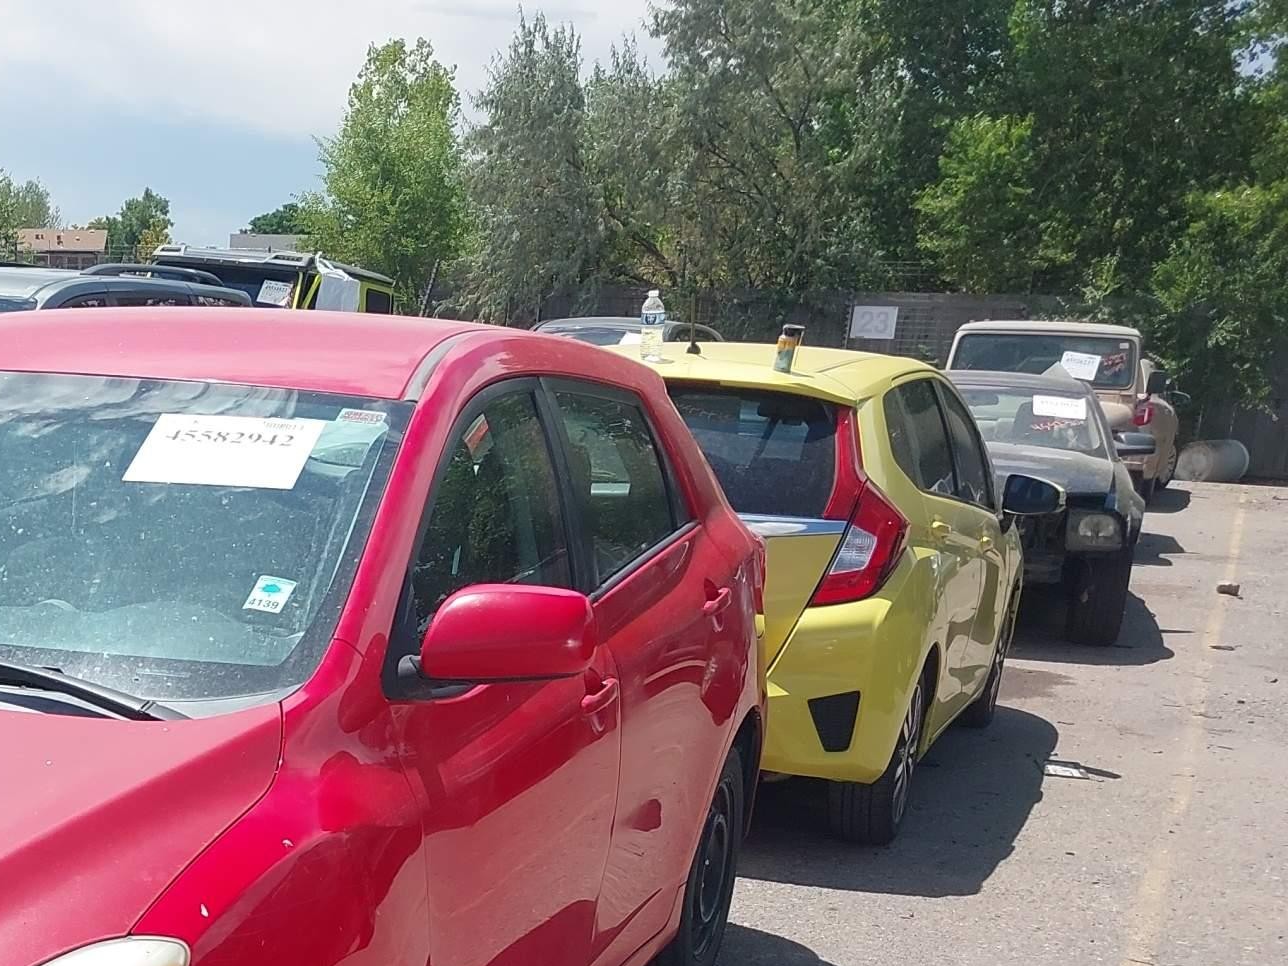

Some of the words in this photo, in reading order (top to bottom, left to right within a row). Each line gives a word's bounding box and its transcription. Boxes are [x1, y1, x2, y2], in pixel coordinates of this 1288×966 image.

[859, 310, 889, 334] 23
[165, 428, 295, 448] 45582942
[247, 598, 280, 610] 4139
